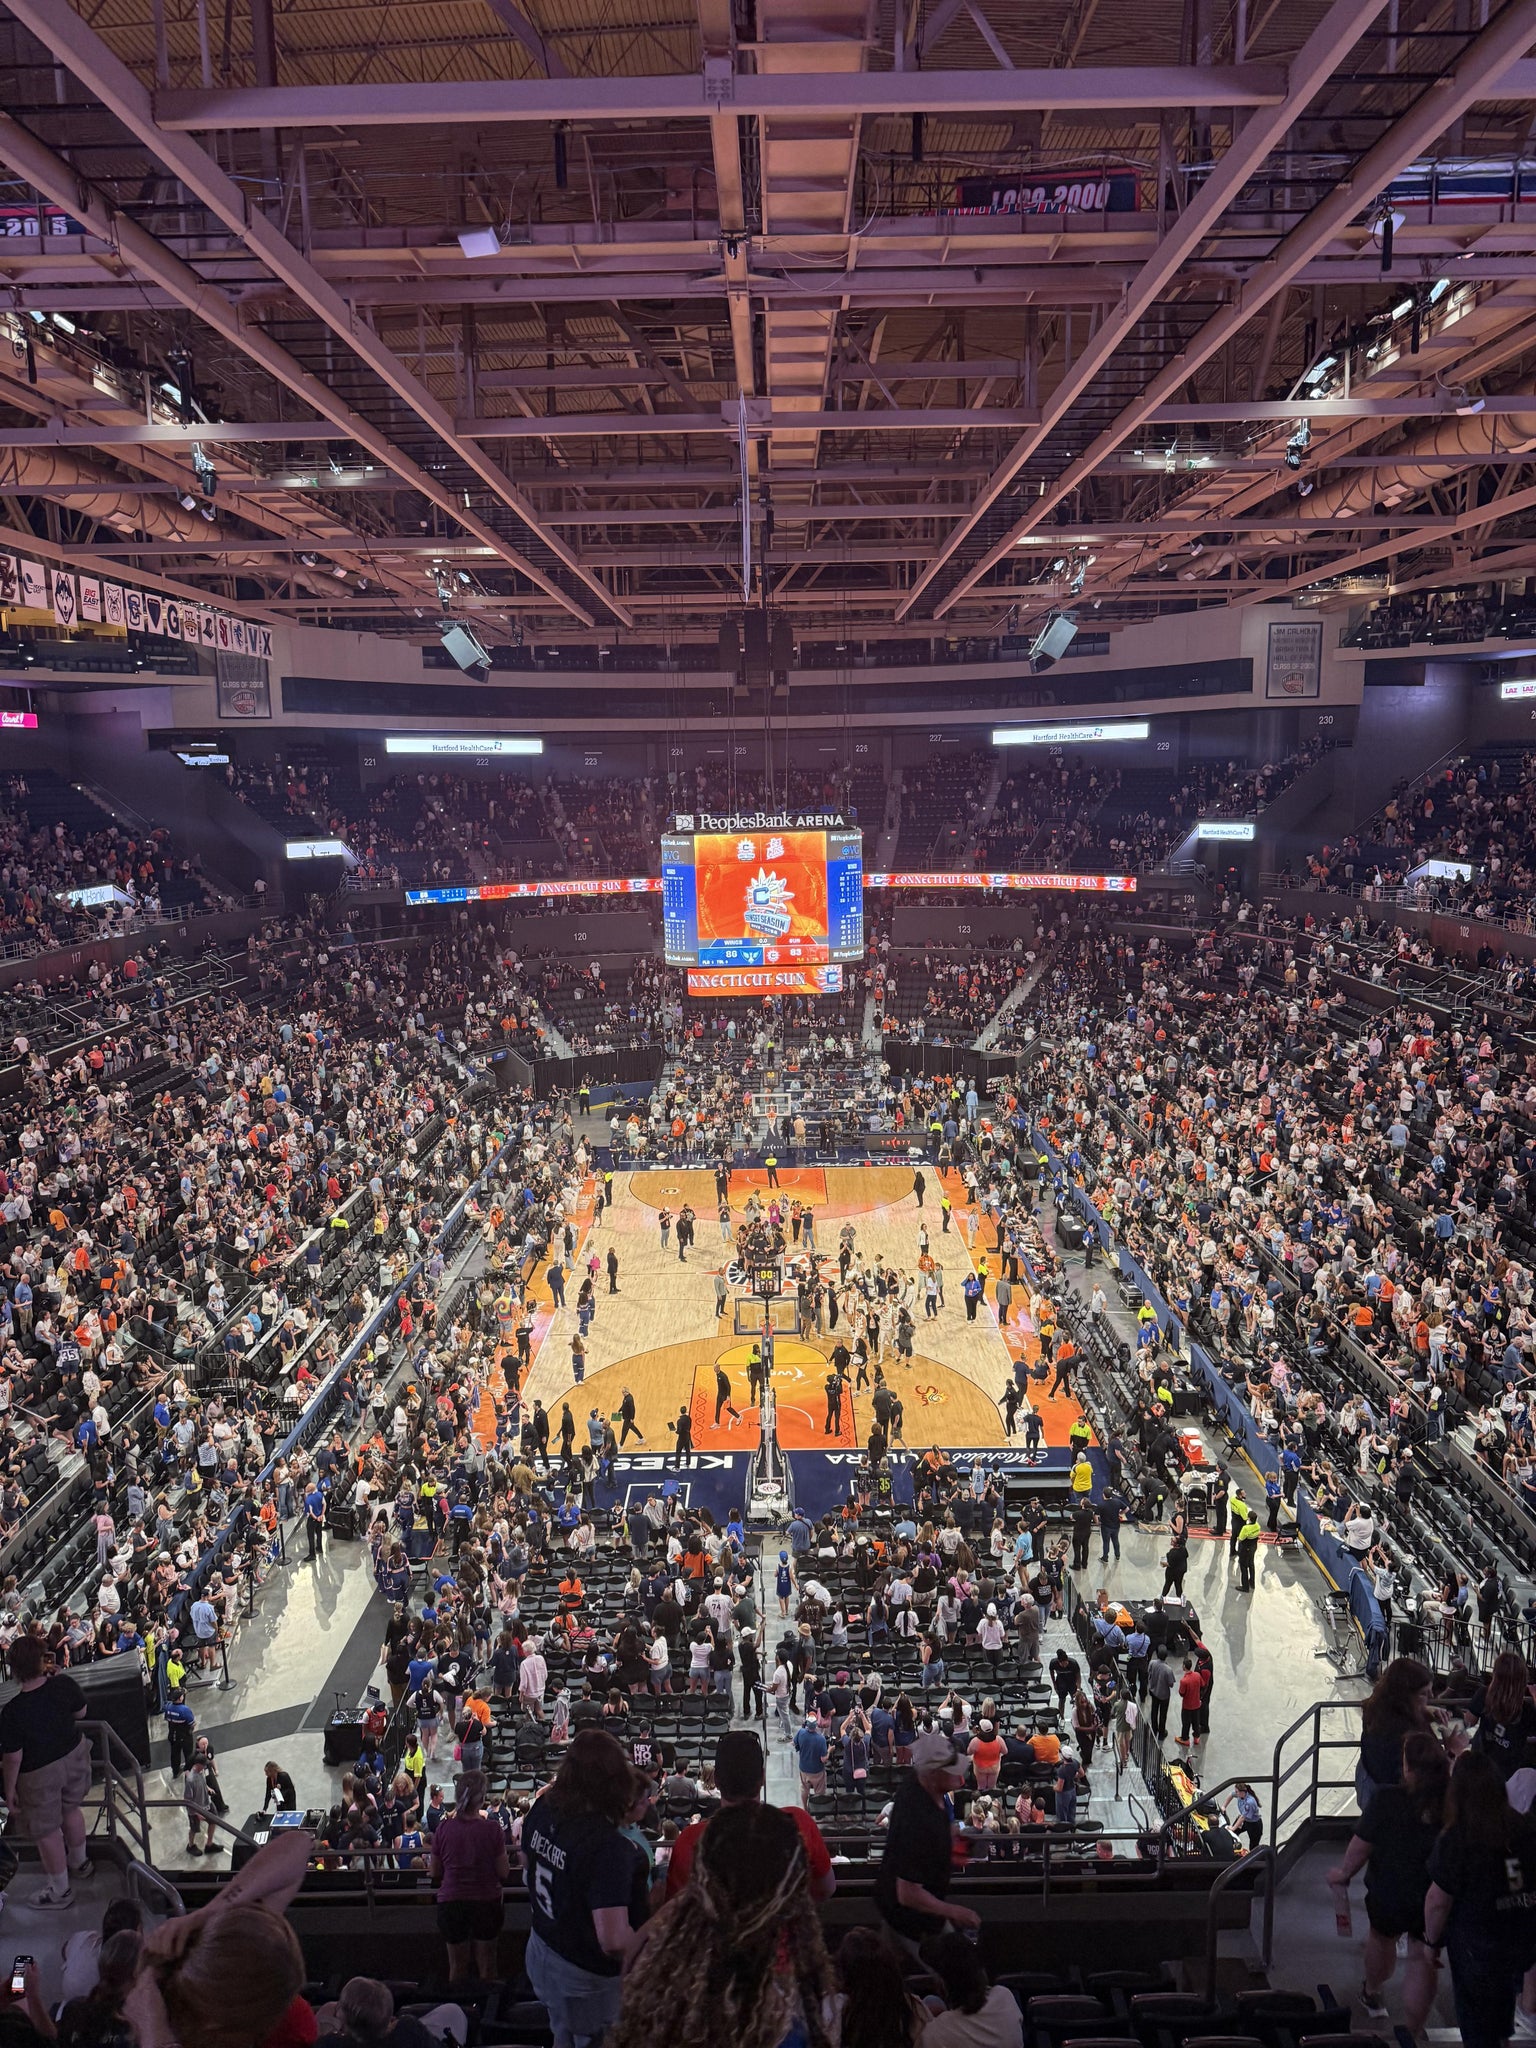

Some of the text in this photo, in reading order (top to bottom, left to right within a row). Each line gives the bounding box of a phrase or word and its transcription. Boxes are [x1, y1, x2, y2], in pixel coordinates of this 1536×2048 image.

[84, 588, 97, 597] BIG
[83, 595, 99, 606] EAST
[168, 604, 180, 635] G
[248, 627, 259, 653] V
[262, 631, 273, 656] X
[222, 681, 240, 689] CLASS
[1318, 715, 1334, 725] 230
[929, 734, 942, 742] 227
[1032, 731, 1093, 742] Hartford HealthCare
[432, 744, 494, 752] Hartford HealthCare
[1157, 742, 1170, 751] 229
[364, 758, 376, 766] 221
[476, 758, 489, 766] 222
[699, 811, 845, 833] PeoplesBank ARENA
[601, 880, 621, 891] SUN
[894, 875, 982, 886] CONNECTICUT SUN
[1013, 875, 1098, 887] CONNECTICUT SUN
[1183, 894, 1195, 904] 124
[760, 914, 786, 930] SEASON
[957, 925, 971, 934] 123
[1459, 925, 1470, 938] 102
[573, 932, 587, 941] 120
[71, 952, 81, 964] 117
[774, 972, 807, 986] SUN
[879, 1477, 891, 1491] 35
[633, 1743, 652, 1752] HEY
[634, 1750, 652, 1761] HO
[534, 1860, 556, 1920] 5
